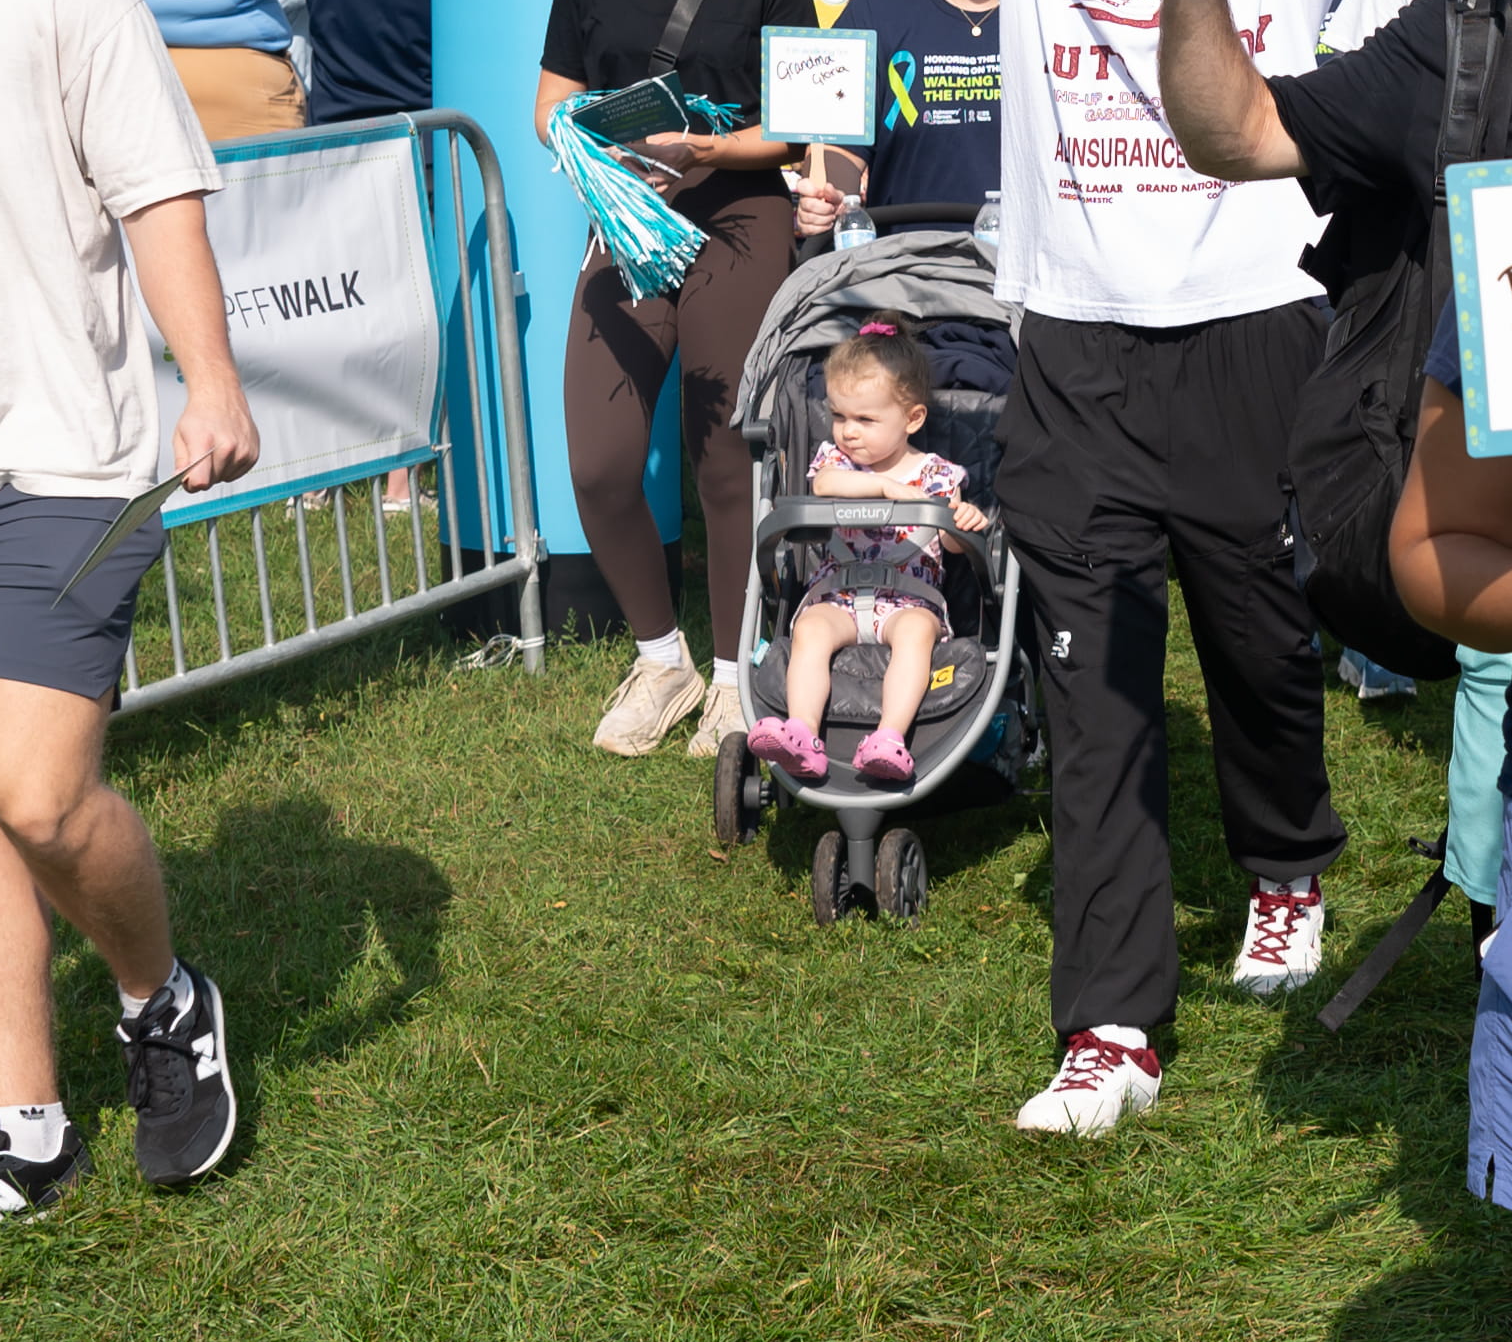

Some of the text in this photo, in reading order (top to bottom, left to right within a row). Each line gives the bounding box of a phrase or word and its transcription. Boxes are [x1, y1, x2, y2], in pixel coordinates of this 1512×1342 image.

[776, 55, 835, 80] Grandma
[923, 75, 994, 88] WALKING
[923, 89, 1002, 102] THE FUTUR
[1067, 136, 1186, 169] INSURANCE
[1086, 183, 1124, 193] LAMAR
[1136, 183, 1178, 193] GRAND
[836, 506, 890, 521] century
